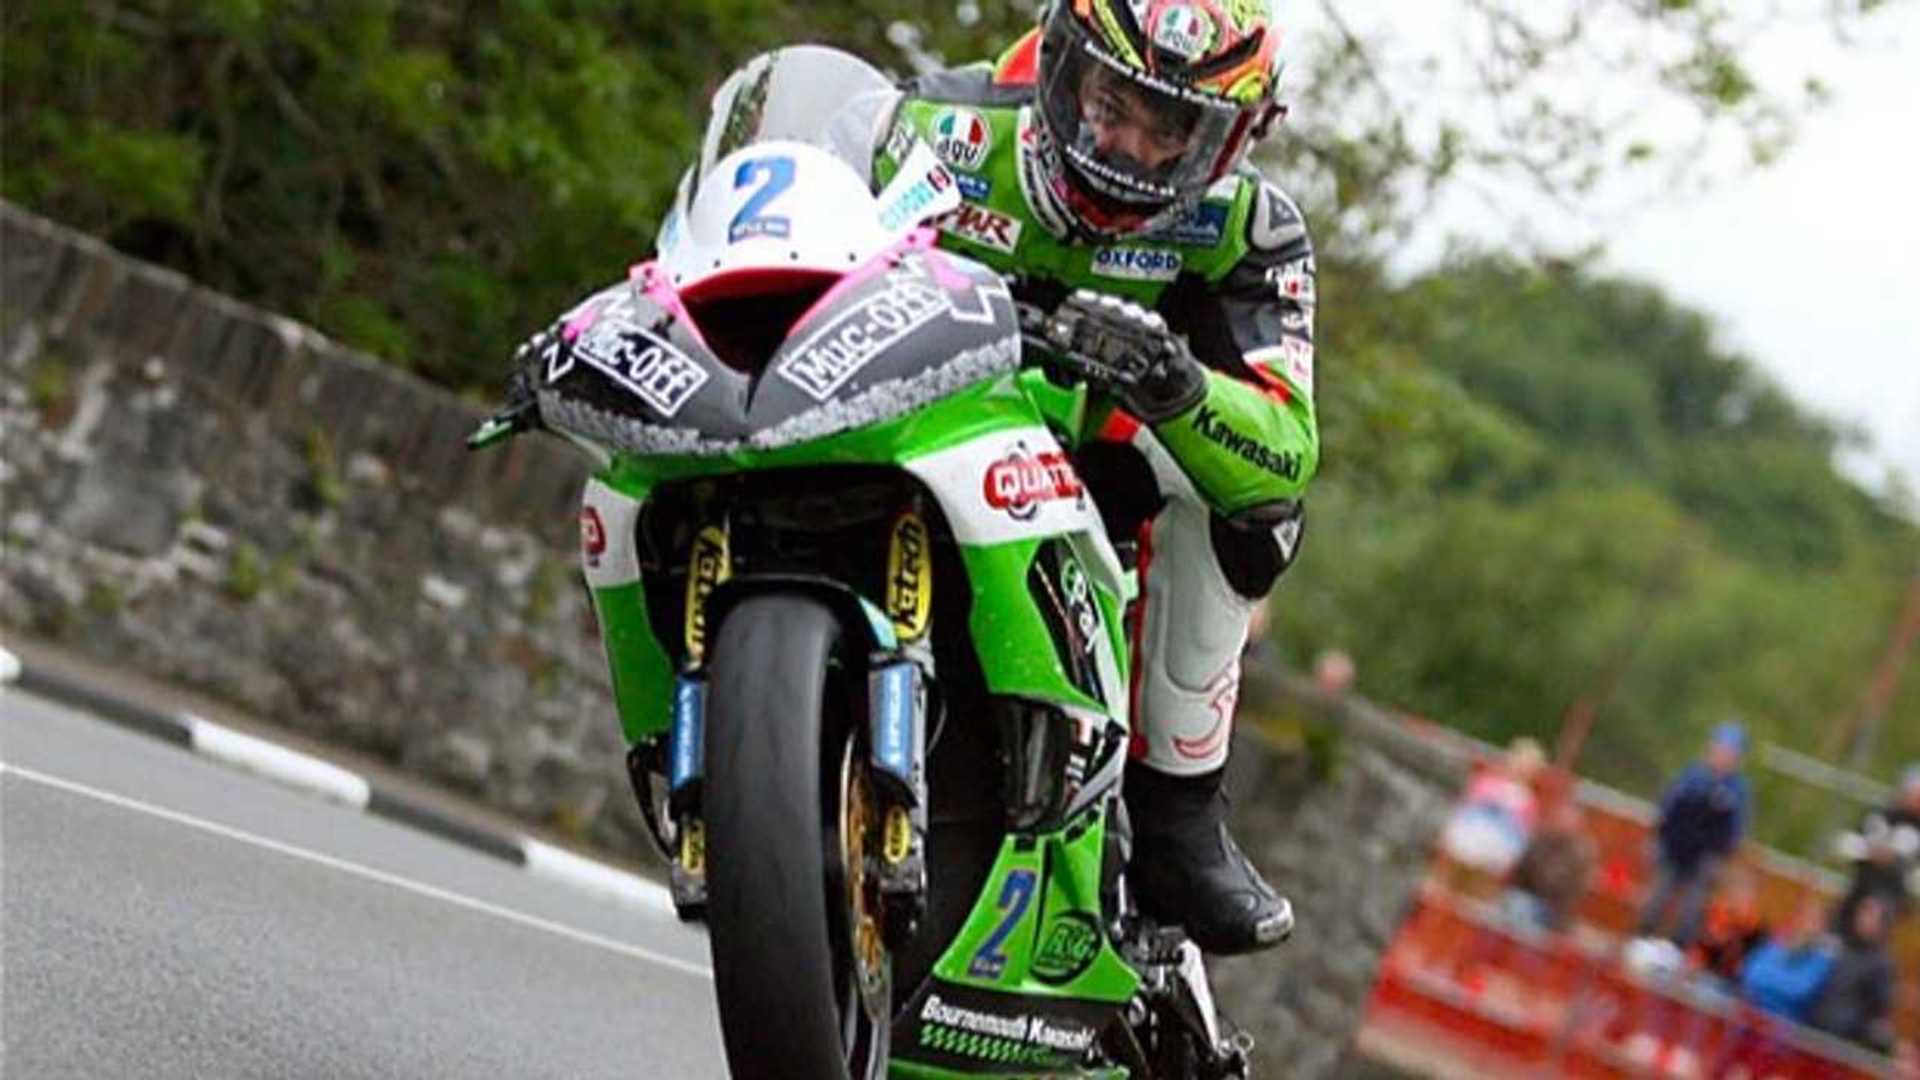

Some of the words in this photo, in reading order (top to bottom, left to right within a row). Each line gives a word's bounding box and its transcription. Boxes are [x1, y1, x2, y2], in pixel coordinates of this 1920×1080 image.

[729, 155, 796, 244] 2
[1096, 249, 1179, 272] OXFORD
[582, 326, 699, 408] c-Off
[792, 282, 942, 390] Muc-Off
[1192, 405, 1302, 482] Kawasaki
[968, 867, 1037, 979] 2
[1028, 1016, 1097, 1050] Kawasak
